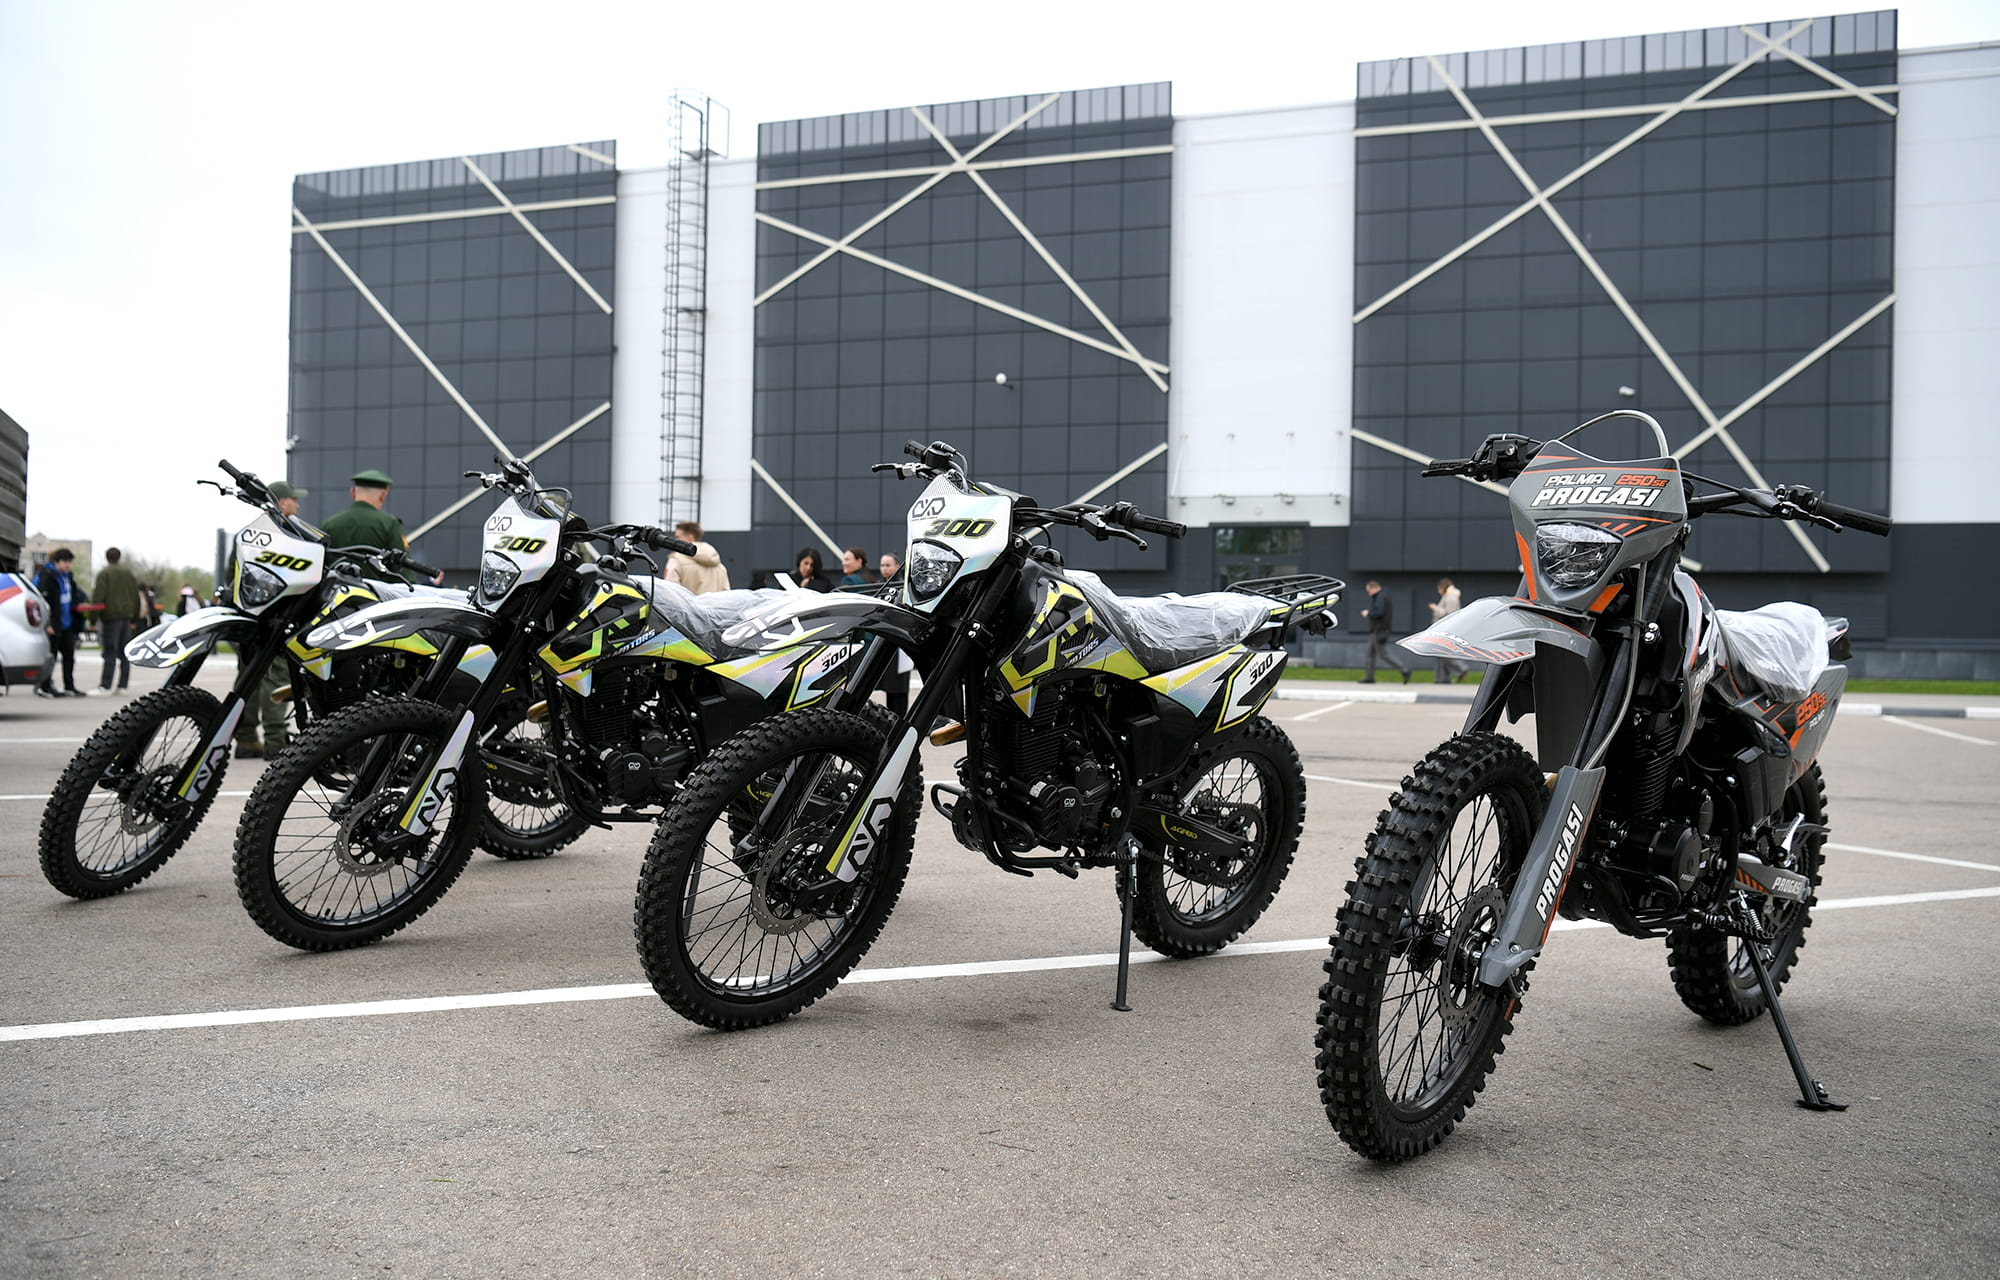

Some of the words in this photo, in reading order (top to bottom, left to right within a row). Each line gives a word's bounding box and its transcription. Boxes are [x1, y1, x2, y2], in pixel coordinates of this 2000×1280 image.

[1544, 473, 1606, 488] PALMA
[1530, 487, 1666, 508] PROGASI
[924, 518, 997, 539] 300
[494, 535, 547, 554] 300
[254, 551, 314, 571] 300
[822, 646, 848, 673] 300
[1249, 653, 1273, 685] 300
[1534, 801, 1584, 923] PROGASI
